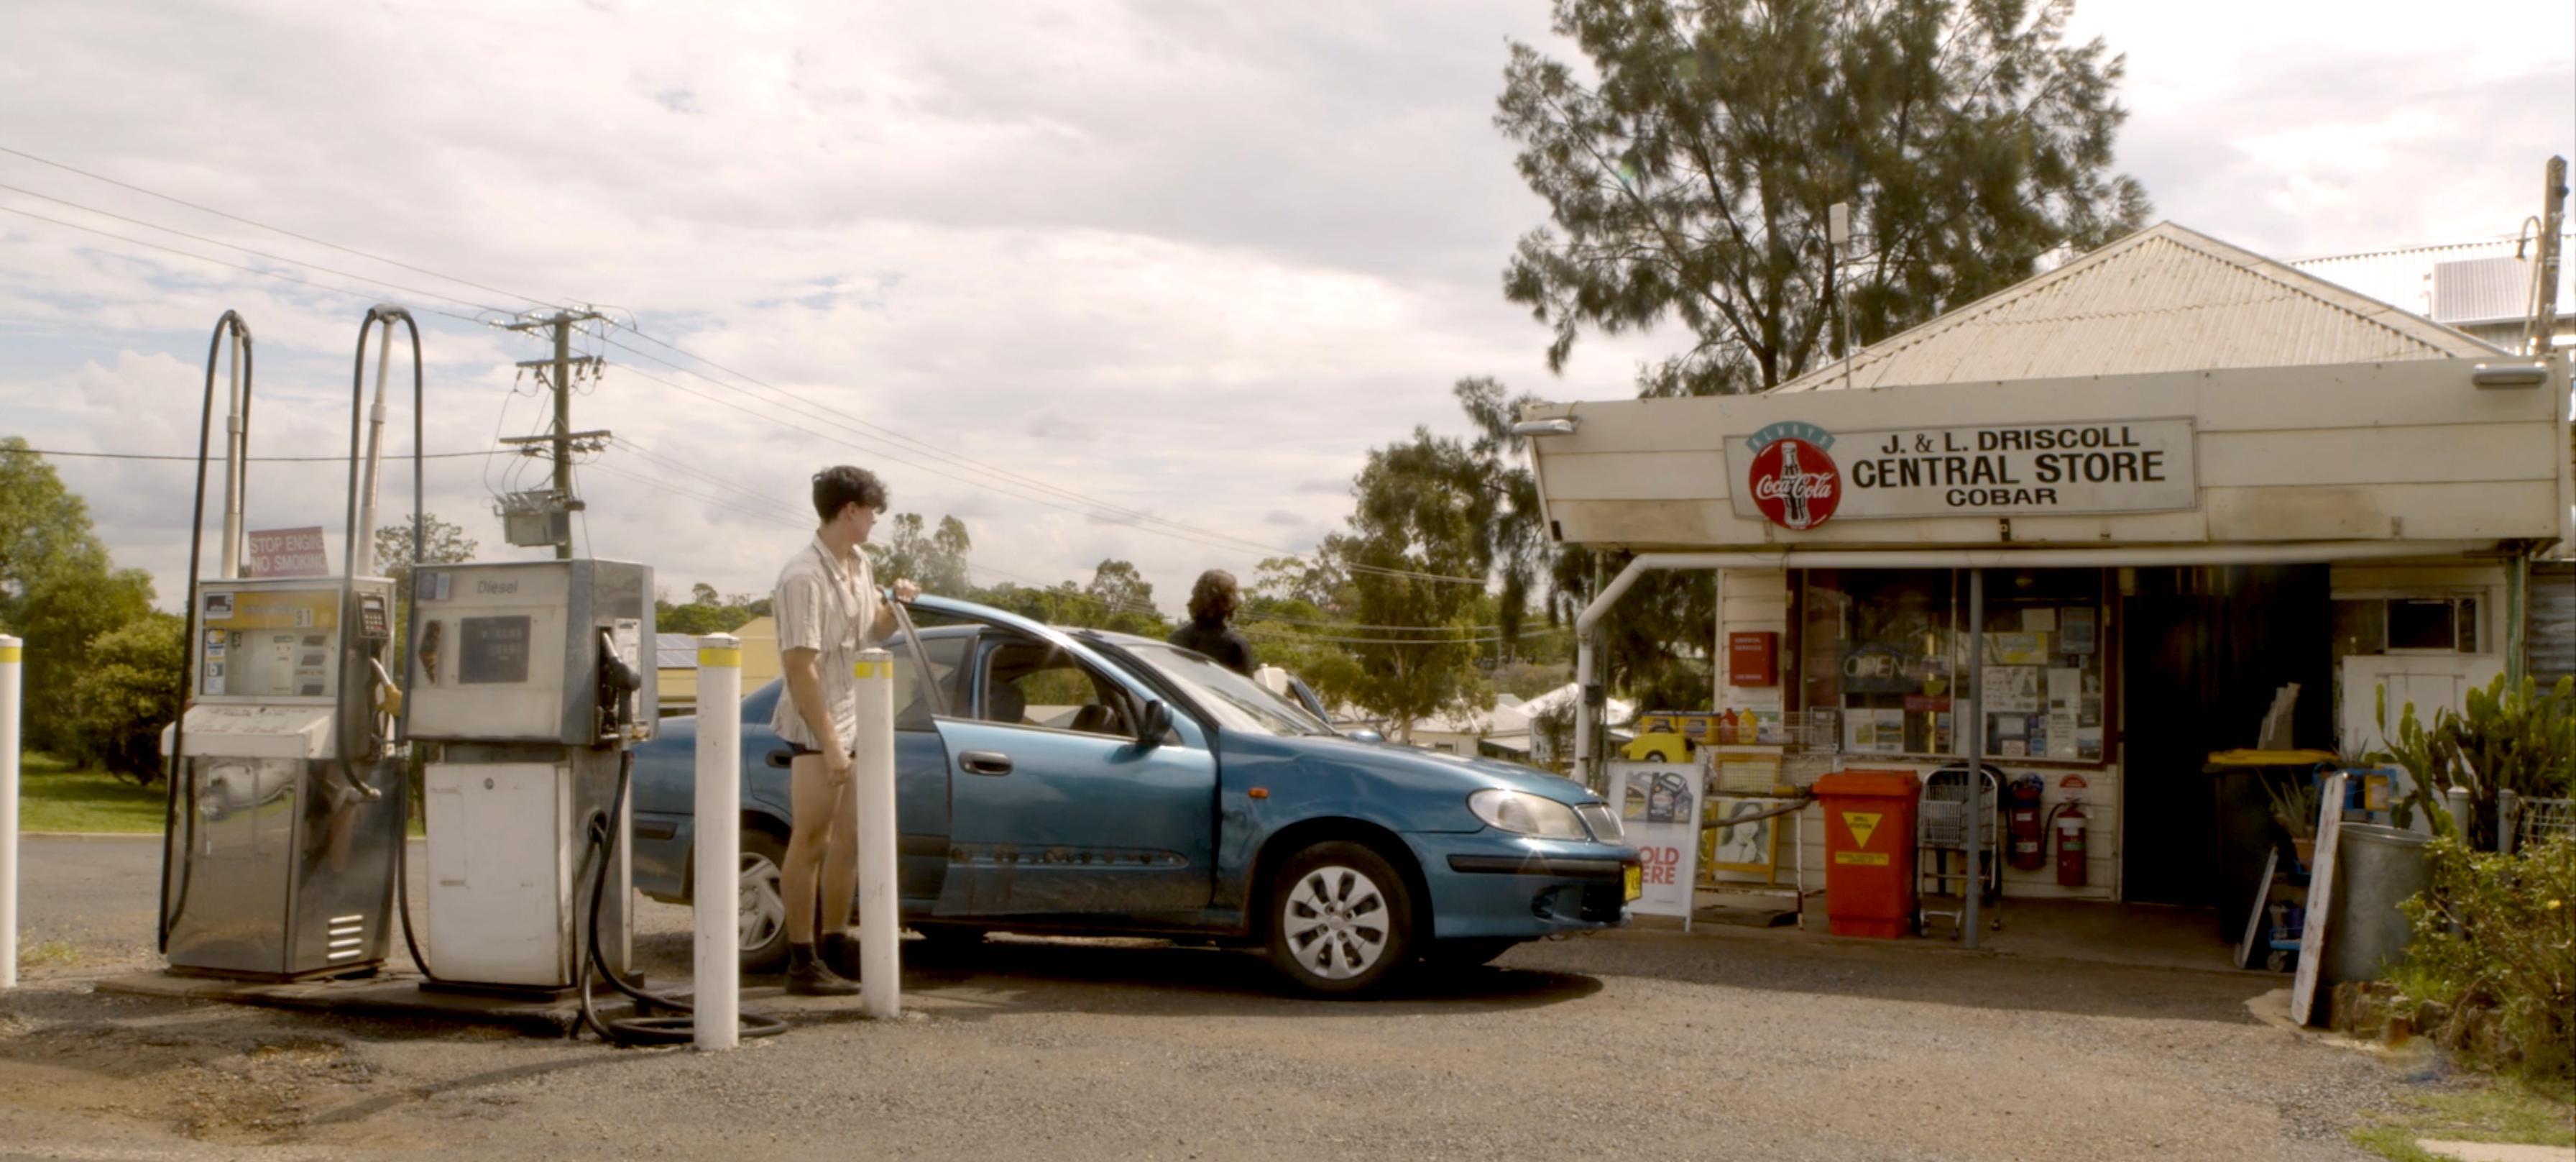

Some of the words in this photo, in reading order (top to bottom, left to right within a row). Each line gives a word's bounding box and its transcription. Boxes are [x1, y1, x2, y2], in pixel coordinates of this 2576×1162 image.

[1752, 424, 1830, 447] ALWAYS
[1881, 434, 1906, 454] J.
[1914, 433, 1934, 453] &
[1944, 432, 1969, 452] L.
[1978, 426, 2140, 452] DRISCOLL
[1852, 455, 2020, 489] CENTRAL
[2035, 450, 2166, 484] STORE
[1756, 472, 1834, 500] Coca-Cola
[1946, 488, 2058, 506] COBAR
[250, 536, 282, 554] STOP
[286, 534, 323, 552] ENGINE
[252, 556, 270, 572] NO
[274, 553, 327, 571] SMOKING
[477, 580, 519, 594] Diesel
[1844, 655, 1909, 677] OPEN
[1639, 846, 1680, 866] OLD
[1642, 866, 1676, 885] ERE
